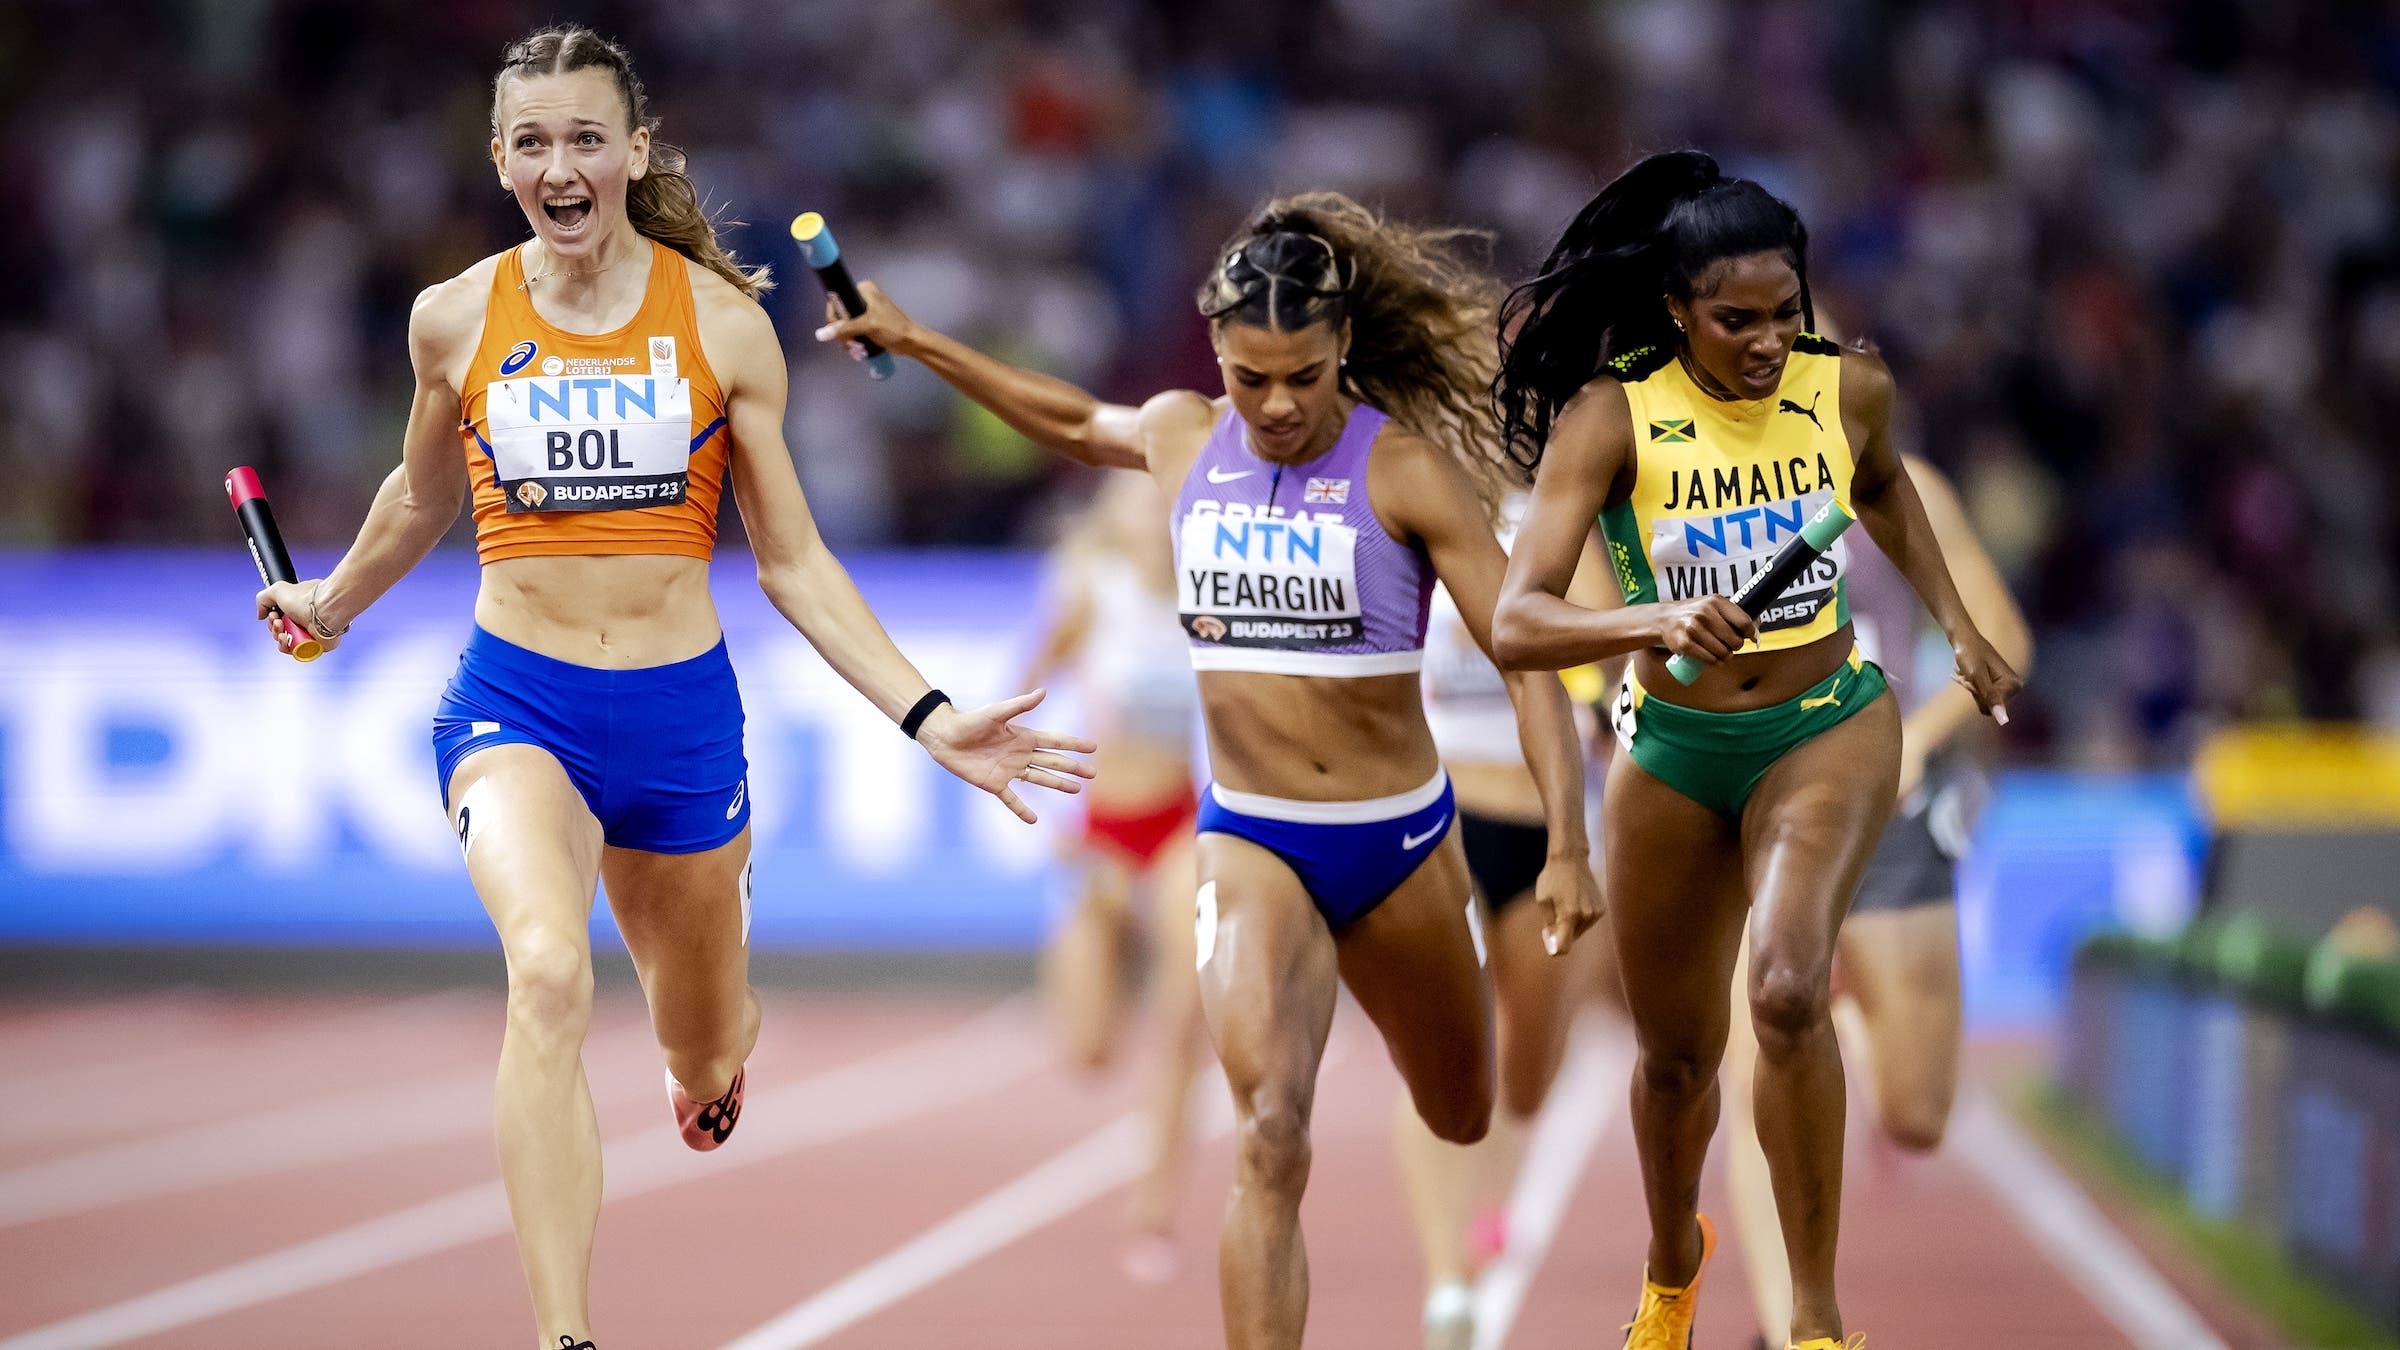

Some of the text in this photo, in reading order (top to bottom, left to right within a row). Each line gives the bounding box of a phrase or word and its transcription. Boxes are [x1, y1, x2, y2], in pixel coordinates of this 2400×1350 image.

[566, 357, 635, 367] NEDERLANDSE
[566, 366, 612, 375] LOTERIJ
[529, 378, 656, 422] NTN
[546, 428, 634, 472] BOL
[553, 481, 679, 501] BUDAPEST 23
[1664, 452, 1836, 510] JAMAICA
[1214, 521, 1322, 566] NTN
[1684, 499, 1804, 558] NTN
[1189, 569, 1346, 612] YEARGIN
[1231, 621, 1354, 640] BUDAPEST 23
